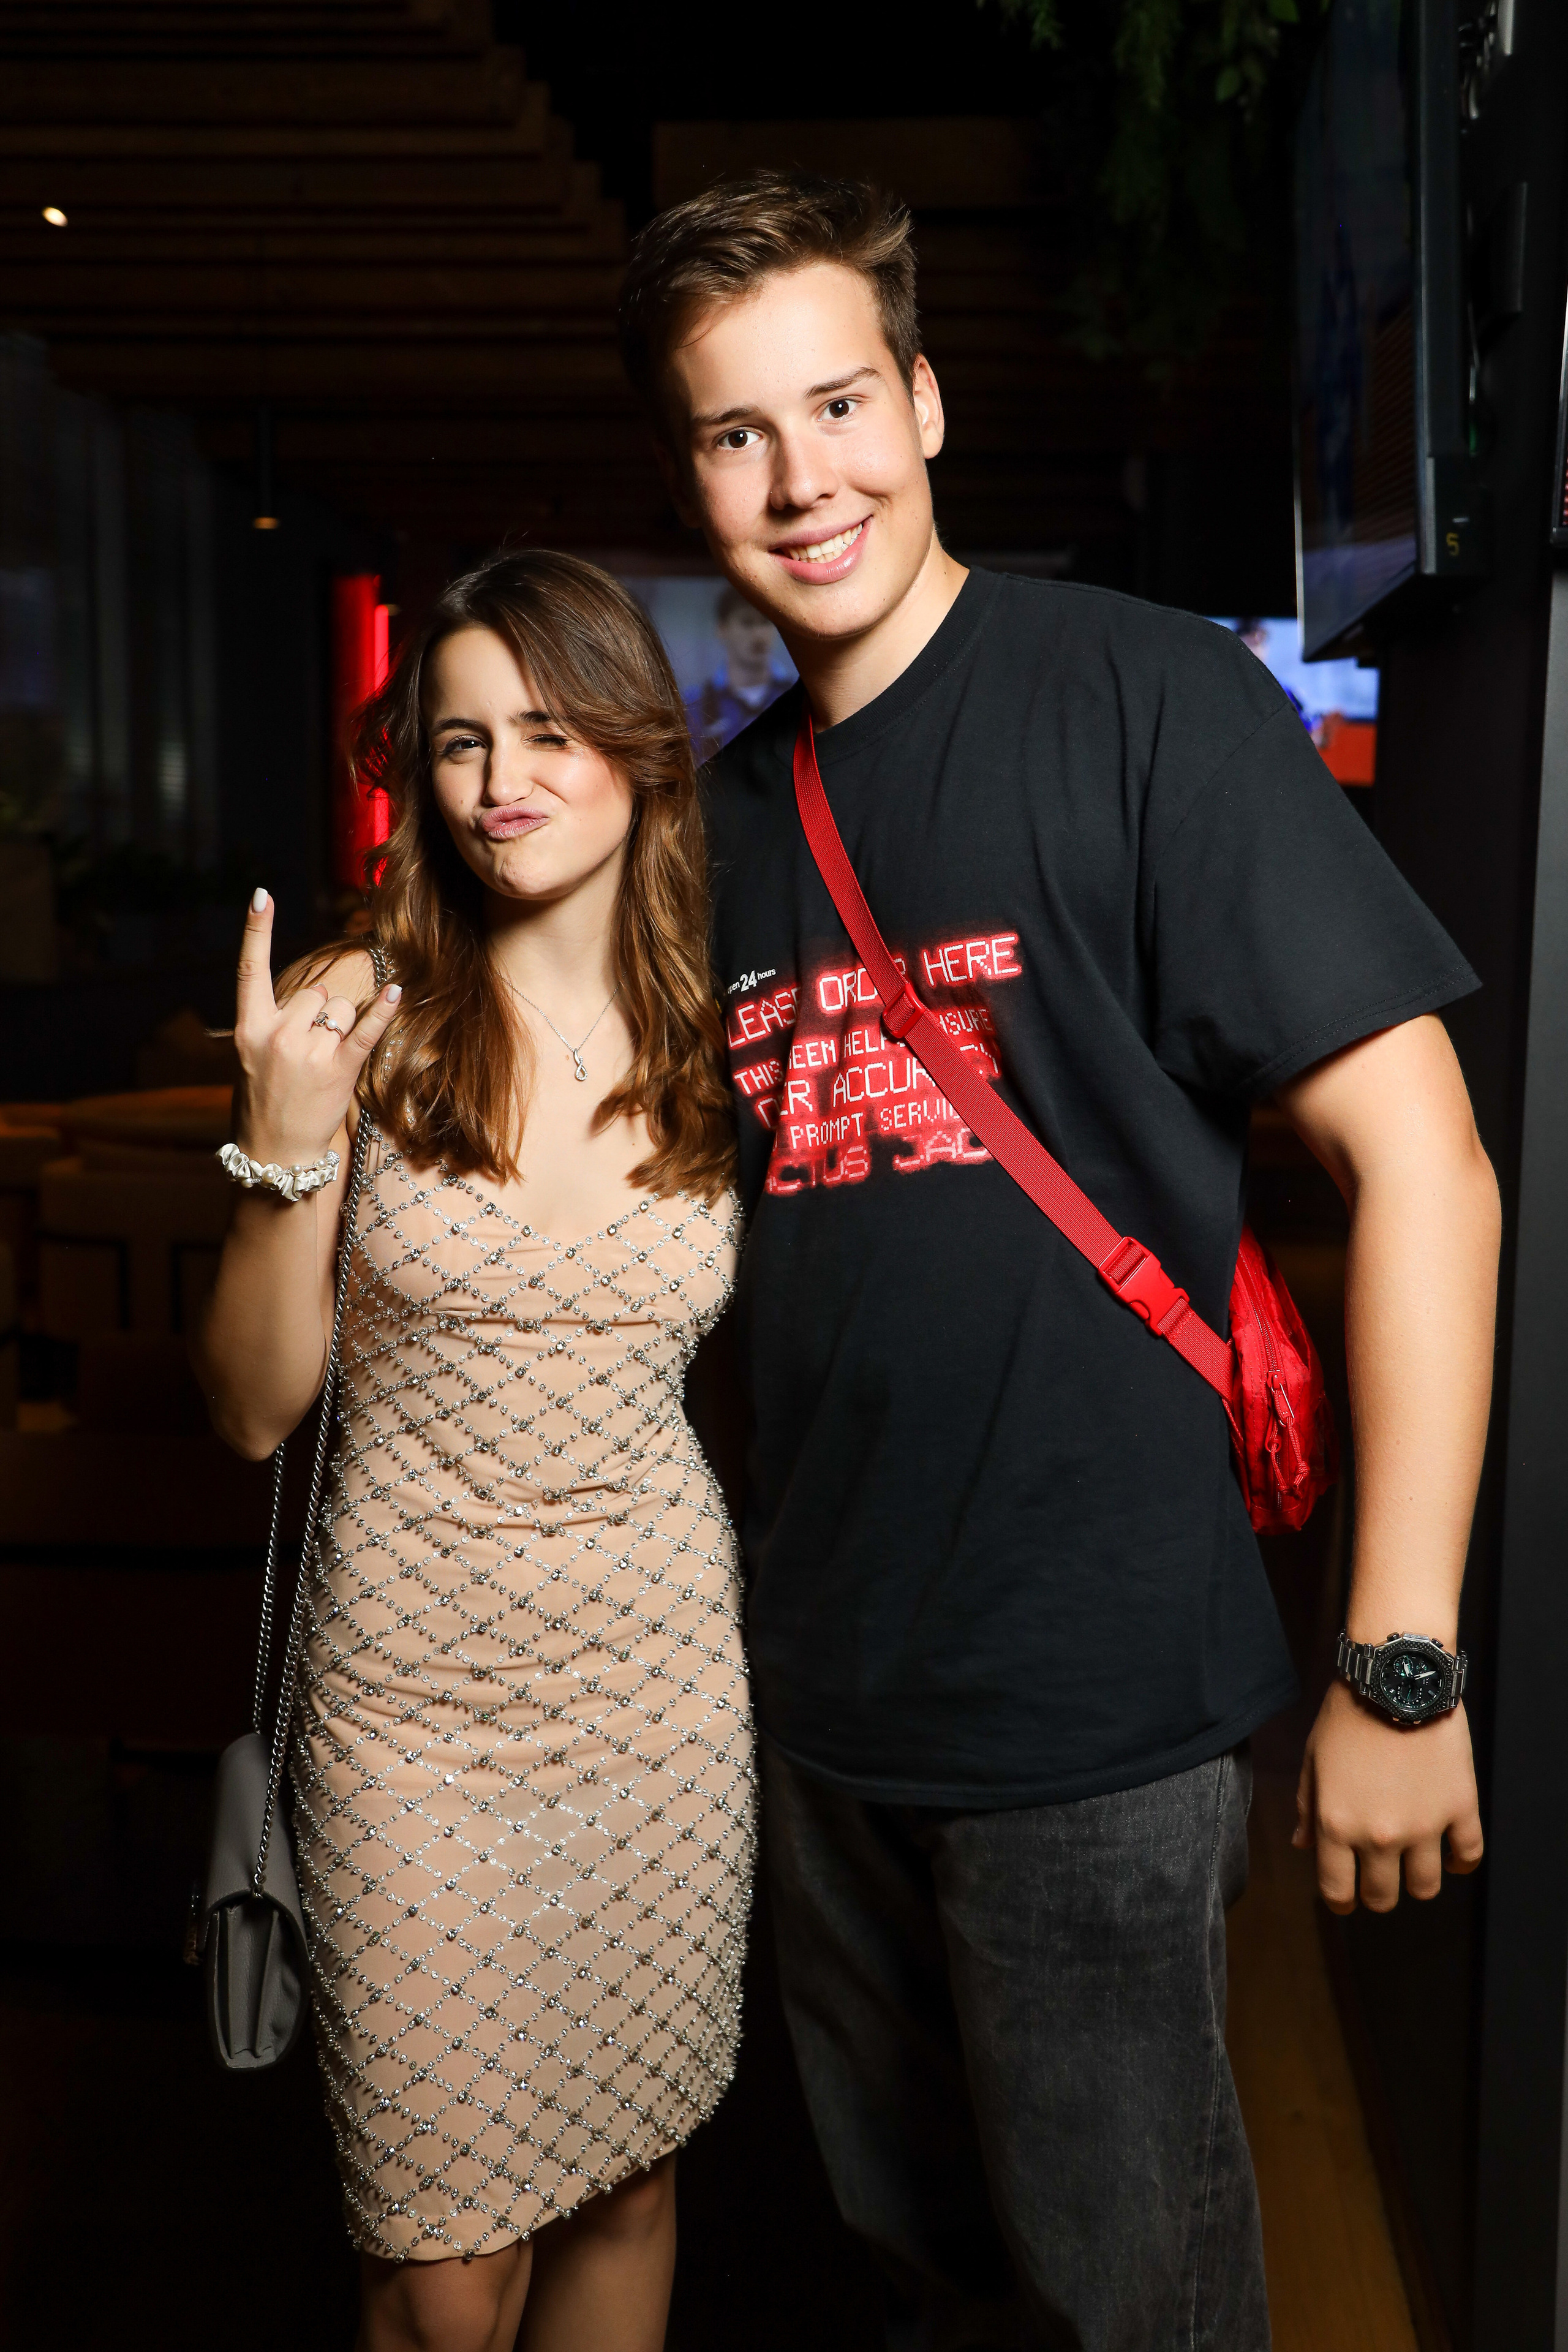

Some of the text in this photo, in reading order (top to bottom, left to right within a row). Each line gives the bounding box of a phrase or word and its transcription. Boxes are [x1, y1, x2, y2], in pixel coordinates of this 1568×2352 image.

[740, 970, 757, 992] 24
[757, 968, 776, 980] hours
[923, 937, 1018, 986] HERE
[734, 1060, 784, 1095] THIS
[790, 1112, 863, 1150] PROMPT
[895, 1127, 988, 1167] JAC
